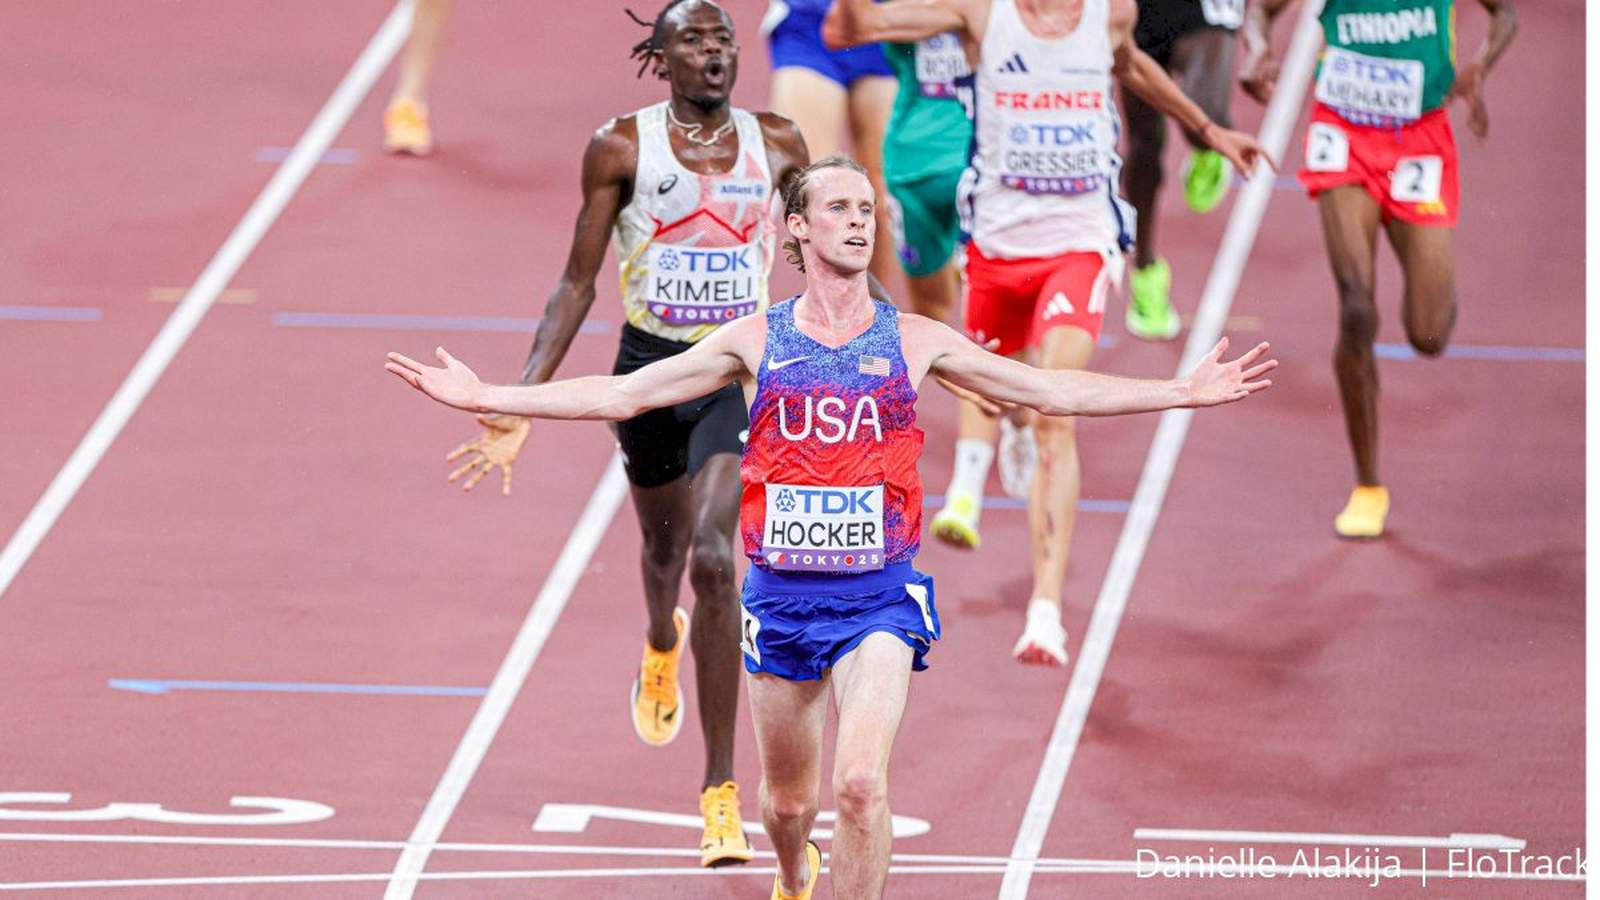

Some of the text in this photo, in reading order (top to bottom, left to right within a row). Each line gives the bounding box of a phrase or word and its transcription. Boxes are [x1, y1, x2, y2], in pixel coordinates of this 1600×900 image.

[1336, 6, 1437, 45] ETHIOPIA
[1354, 60, 1410, 84] TDK
[994, 90, 1103, 109] FRANCE
[1031, 124, 1094, 145] TDK
[1315, 132, 1332, 164] 2
[1006, 151, 1099, 172] GRESSIER
[1408, 161, 1425, 194] 2
[681, 250, 750, 272] TDK
[656, 277, 752, 301] KIMELI
[778, 396, 882, 443] USA
[796, 490, 874, 514] TDK
[770, 520, 876, 547] HOCKER
